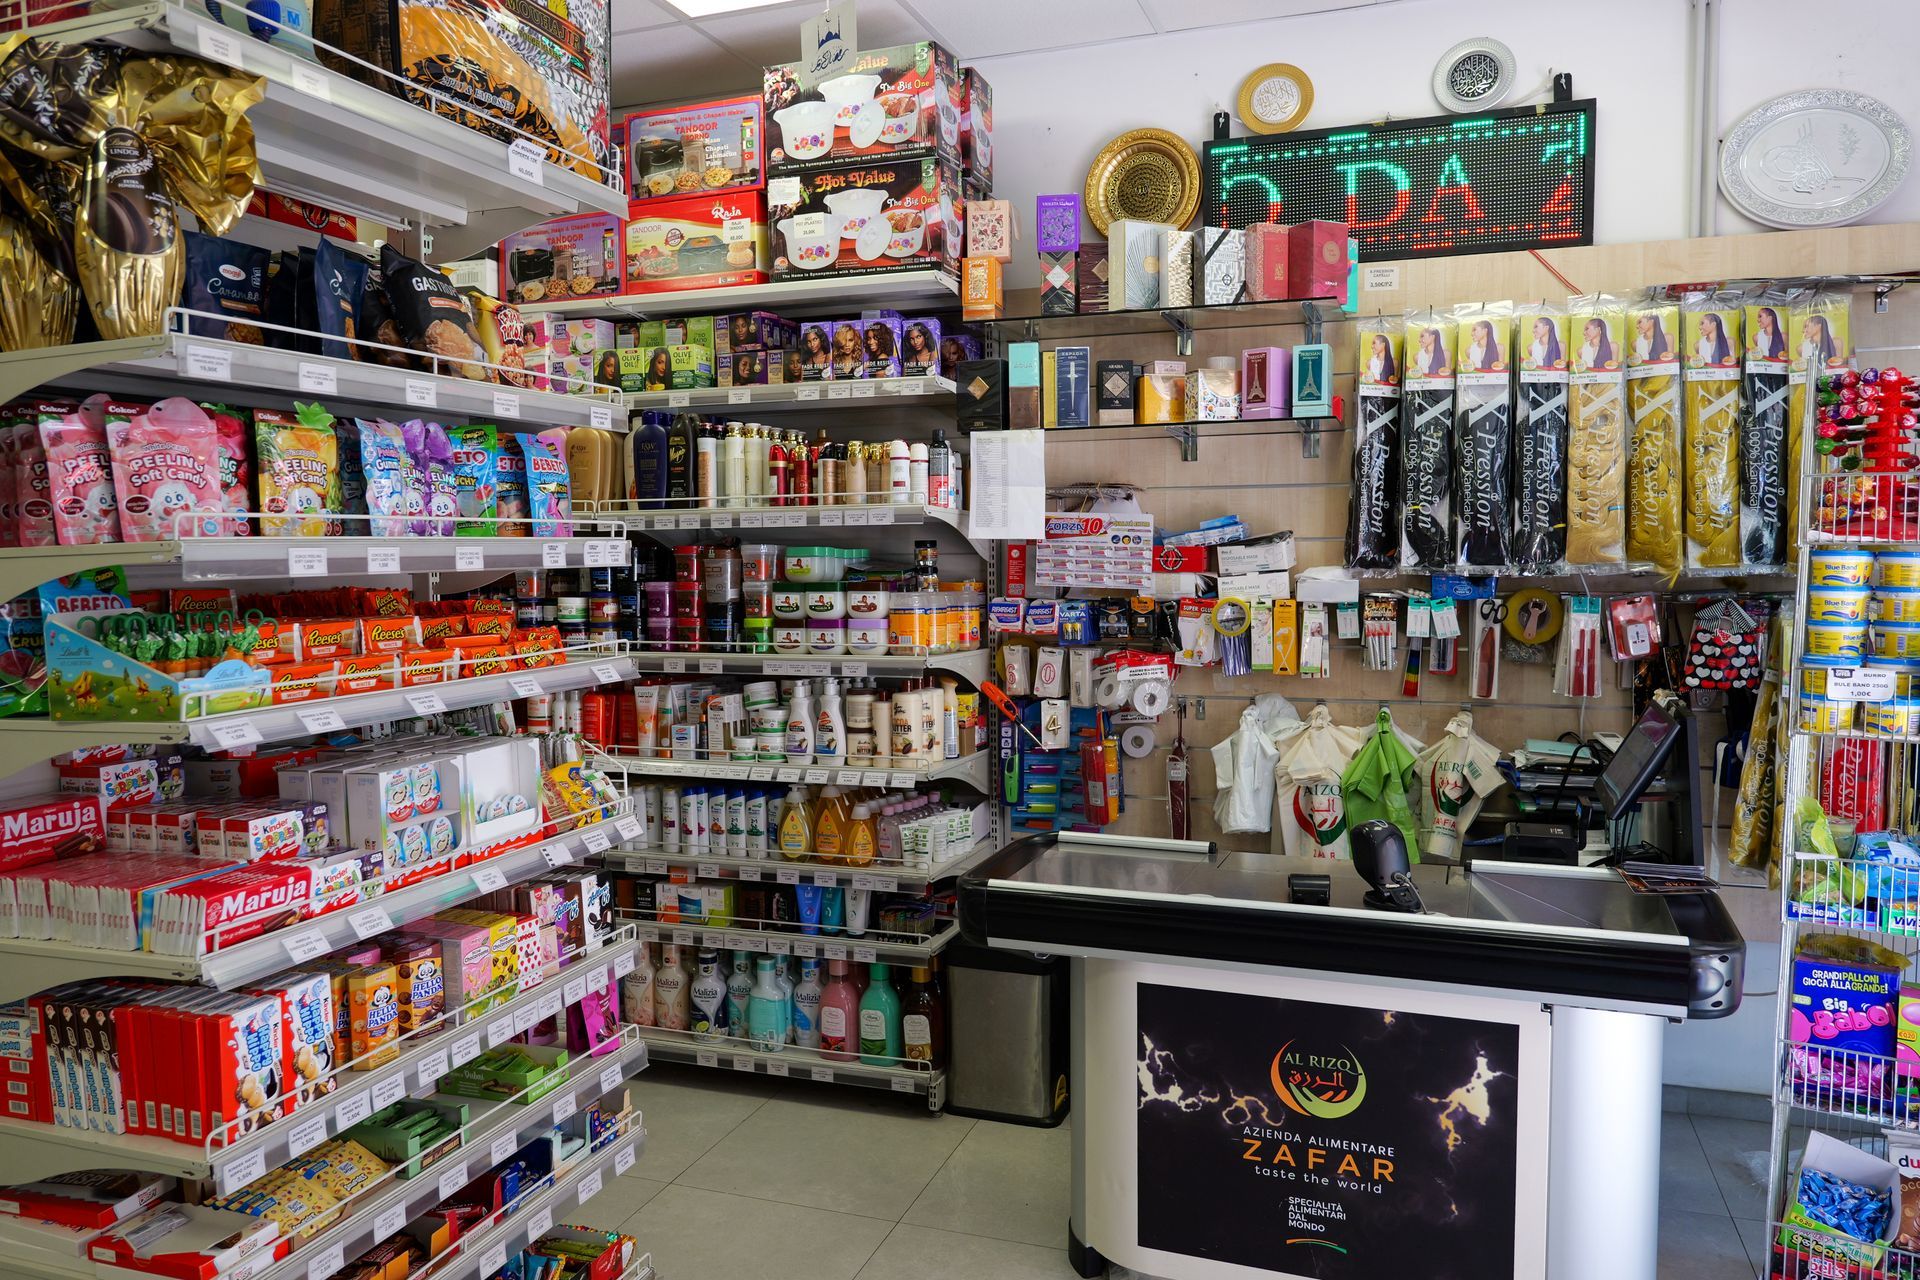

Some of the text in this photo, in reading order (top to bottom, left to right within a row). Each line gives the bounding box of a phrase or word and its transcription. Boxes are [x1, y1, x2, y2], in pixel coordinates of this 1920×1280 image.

[505, 1, 582, 48] MOUHAJIR
[880, 80, 930, 92] The Big One
[675, 121, 718, 135] TANDOOR
[110, 148, 140, 157] LINDOR
[922, 165, 934, 177] 3
[814, 170, 896, 193] Hot Value
[887, 196, 936, 208] The Big One
[632, 224, 662, 234] TANDOOR
[546, 233, 584, 246] TANDOOR
[673, 351, 692, 359] OLIVE
[130, 453, 205, 474] PEELING
[273, 460, 328, 477] PEELING
[532, 457, 567, 474] BEBETO
[130, 468, 207, 489] Soft Candy
[273, 472, 328, 490] Soft Candy
[1462, 434, 1474, 530] 100% Kanekalon
[1046, 522, 1084, 534] FORZA
[1082, 518, 1103, 534] 10
[308, 629, 343, 647] Reese's
[371, 625, 406, 642] Reese's
[1006, 663, 1017, 685] 6
[1046, 714, 1061, 737] 4
[115, 764, 143, 780] Kinder
[2, 801, 97, 841] Maruja
[262, 817, 289, 834] Kinder
[323, 867, 349, 884] Kinder
[219, 877, 307, 921] Maruja
[1792, 905, 1838, 919] FRESHGUM
[412, 975, 442, 994] HELLO
[656, 977, 679, 986] Malizia
[1812, 969, 1880, 984] GRANDI PALLONI
[411, 982, 444, 1001] PANDA
[693, 987, 718, 996] Malizia
[728, 984, 751, 993] Malizia
[1802, 977, 1889, 994] GIOCA ALLA GRANDE!
[796, 992, 822, 1001] Malizia
[1822, 997, 1849, 1012] Big
[368, 1001, 398, 1020] HELLO
[367, 1010, 399, 1029] PANDA
[1812, 1002, 1897, 1040] Babol
[1283, 1053, 1362, 1076] AL RIZQ
[1289, 1069, 1344, 1088] الرزق
[1243, 1126, 1395, 1157] AZIENDA ALIMENTARE
[1242, 1138, 1394, 1182] ZAFAR
[1255, 1165, 1382, 1195] taste the world
[1288, 1195, 1343, 1212] SPECIALITÀ
[1288, 1204, 1346, 1220] ALIMENTARI
[1288, 1212, 1307, 1222] DAL
[1288, 1220, 1325, 1233] MONDO
